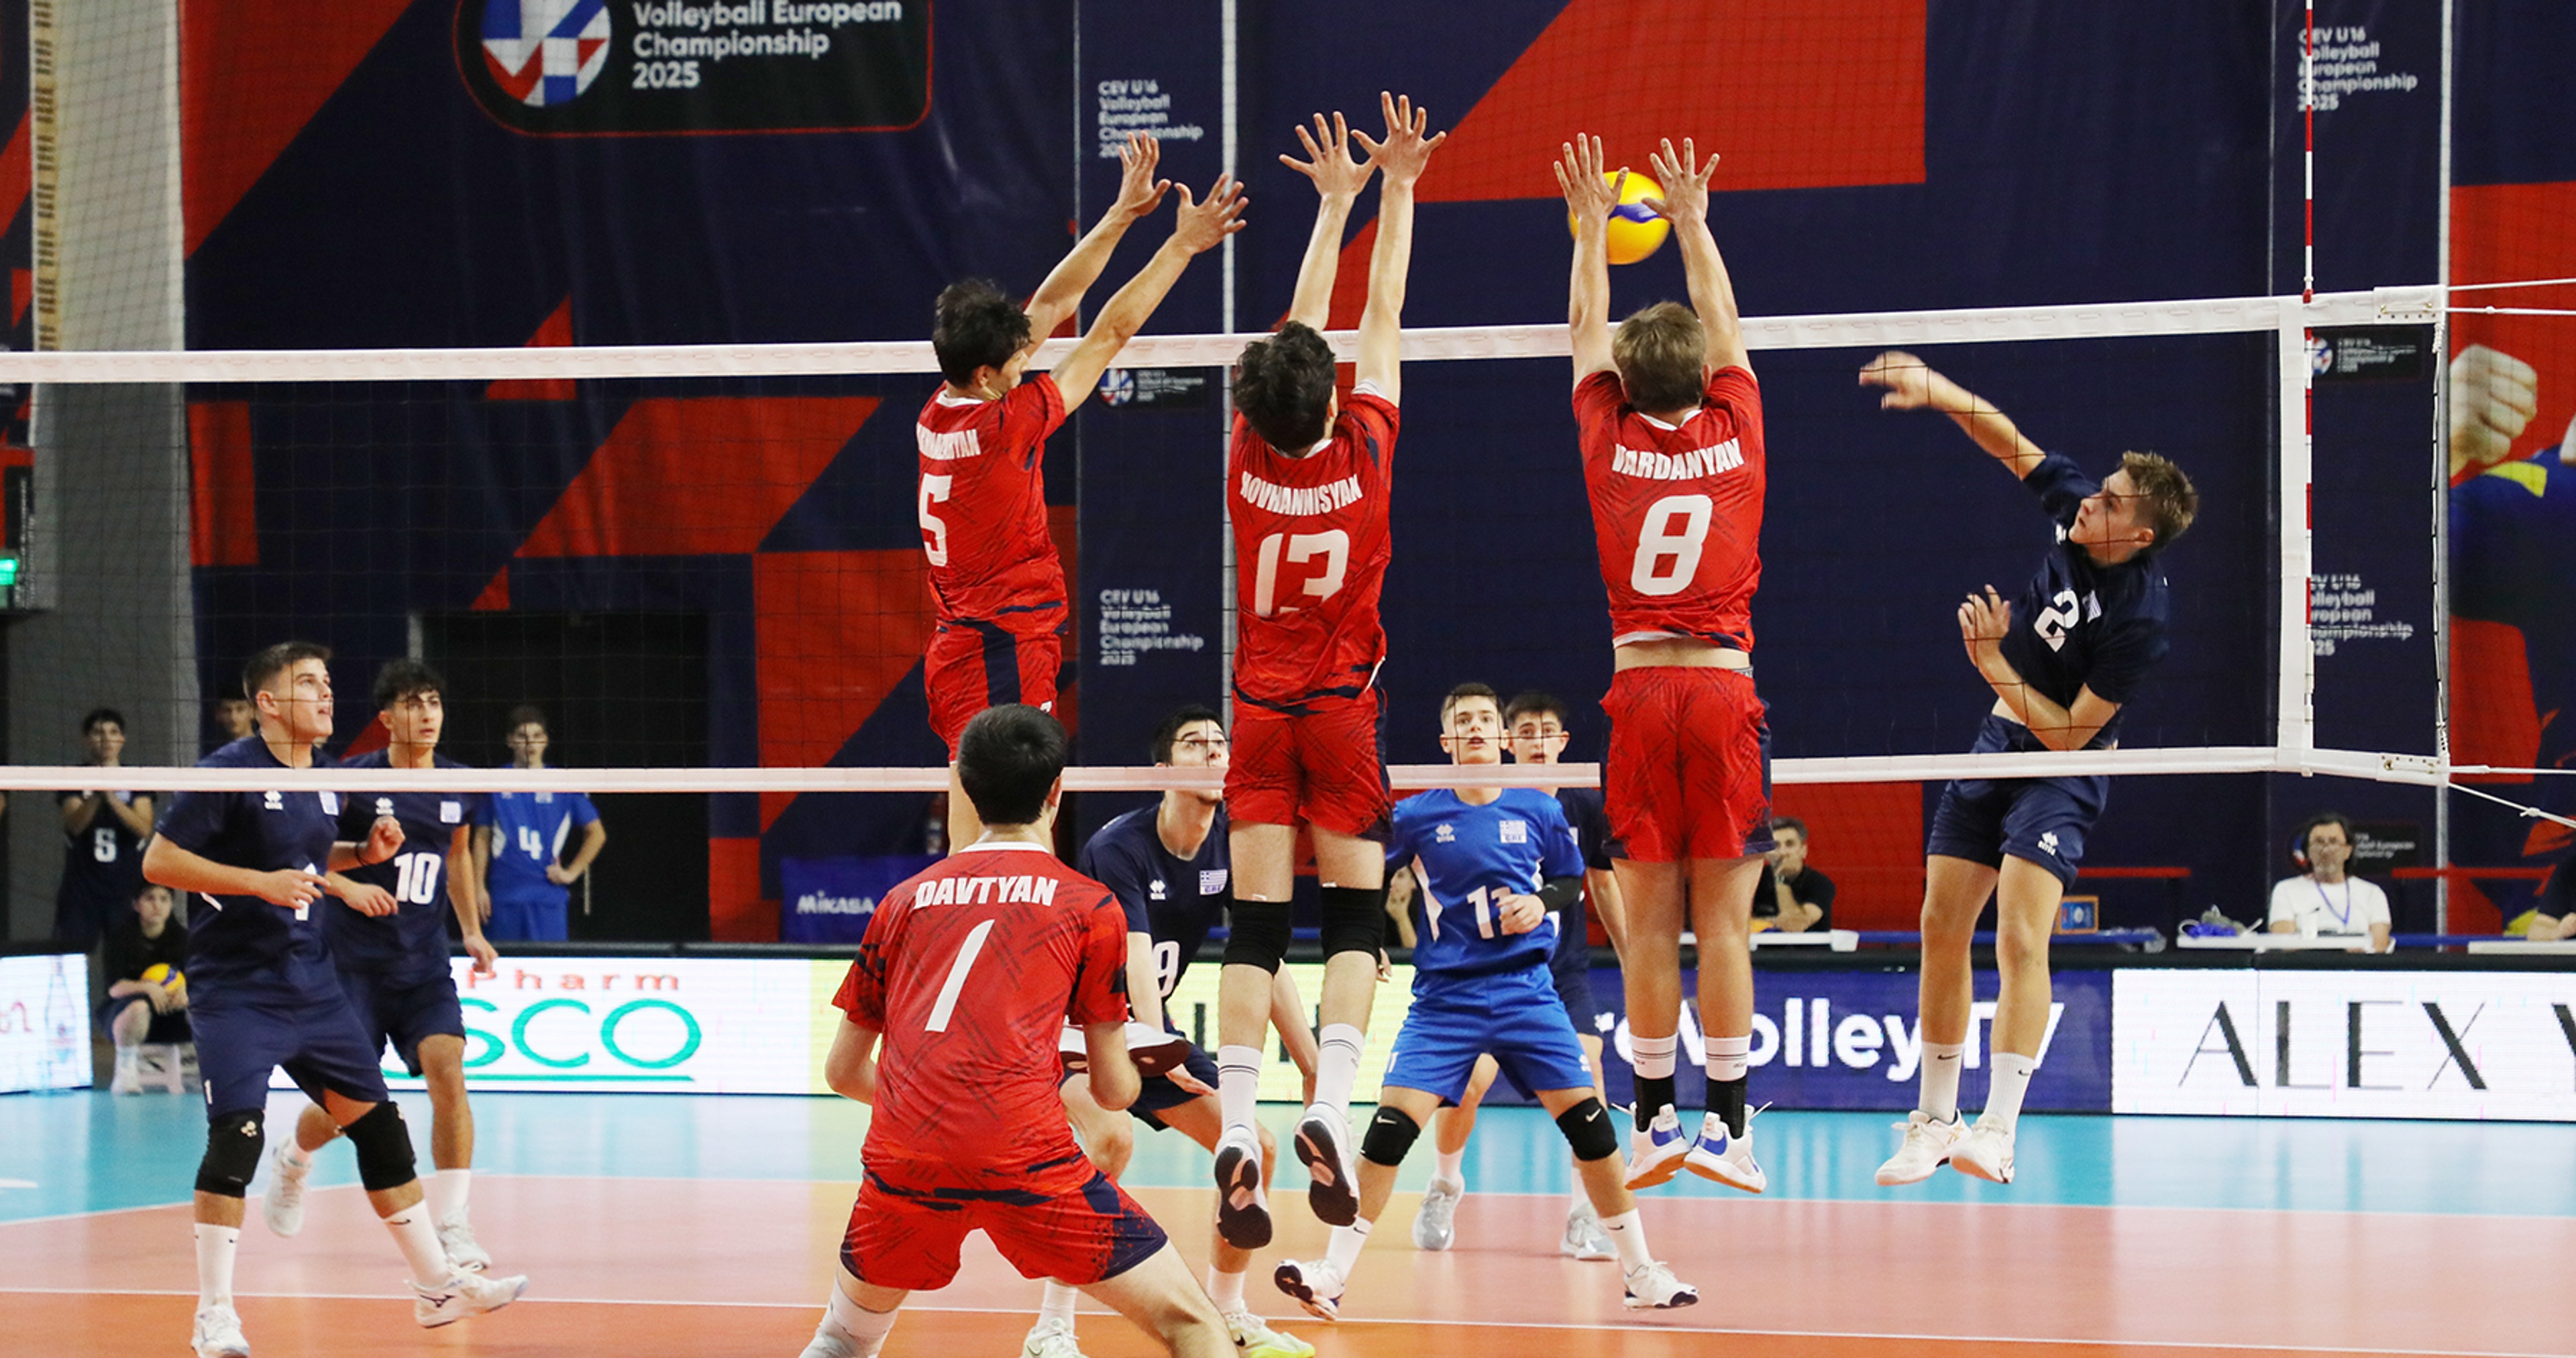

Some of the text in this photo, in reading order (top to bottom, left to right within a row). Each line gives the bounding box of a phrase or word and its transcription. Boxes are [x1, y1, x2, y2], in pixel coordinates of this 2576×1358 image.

[632, 0, 902, 32] Volleyball European
[632, 27, 830, 61] Championship
[2299, 41, 2380, 62] Volleyball
[631, 61, 701, 89] 2025
[1097, 79, 1128, 96] CEV
[2298, 72, 2418, 95] Championship
[1097, 110, 1169, 127] European
[1098, 93, 1171, 112] Volleyball
[1611, 437, 1744, 480] VARDANYAN
[918, 472, 953, 567] 5
[1630, 494, 1713, 596] 8
[1254, 528, 1350, 618] 13
[2311, 589, 2375, 609] olleyball
[2311, 608, 2372, 624] ropean
[2033, 589, 2080, 653] 2
[2312, 621, 2414, 642] ampionship
[93, 827, 117, 863] 5
[518, 826, 543, 860] 4
[394, 852, 442, 905] 10
[913, 875, 1059, 909] DAVTYAN
[467, 968, 680, 991] Pharm
[924, 919, 996, 1033] 1
[2178, 1000, 2489, 1092] ALEX
